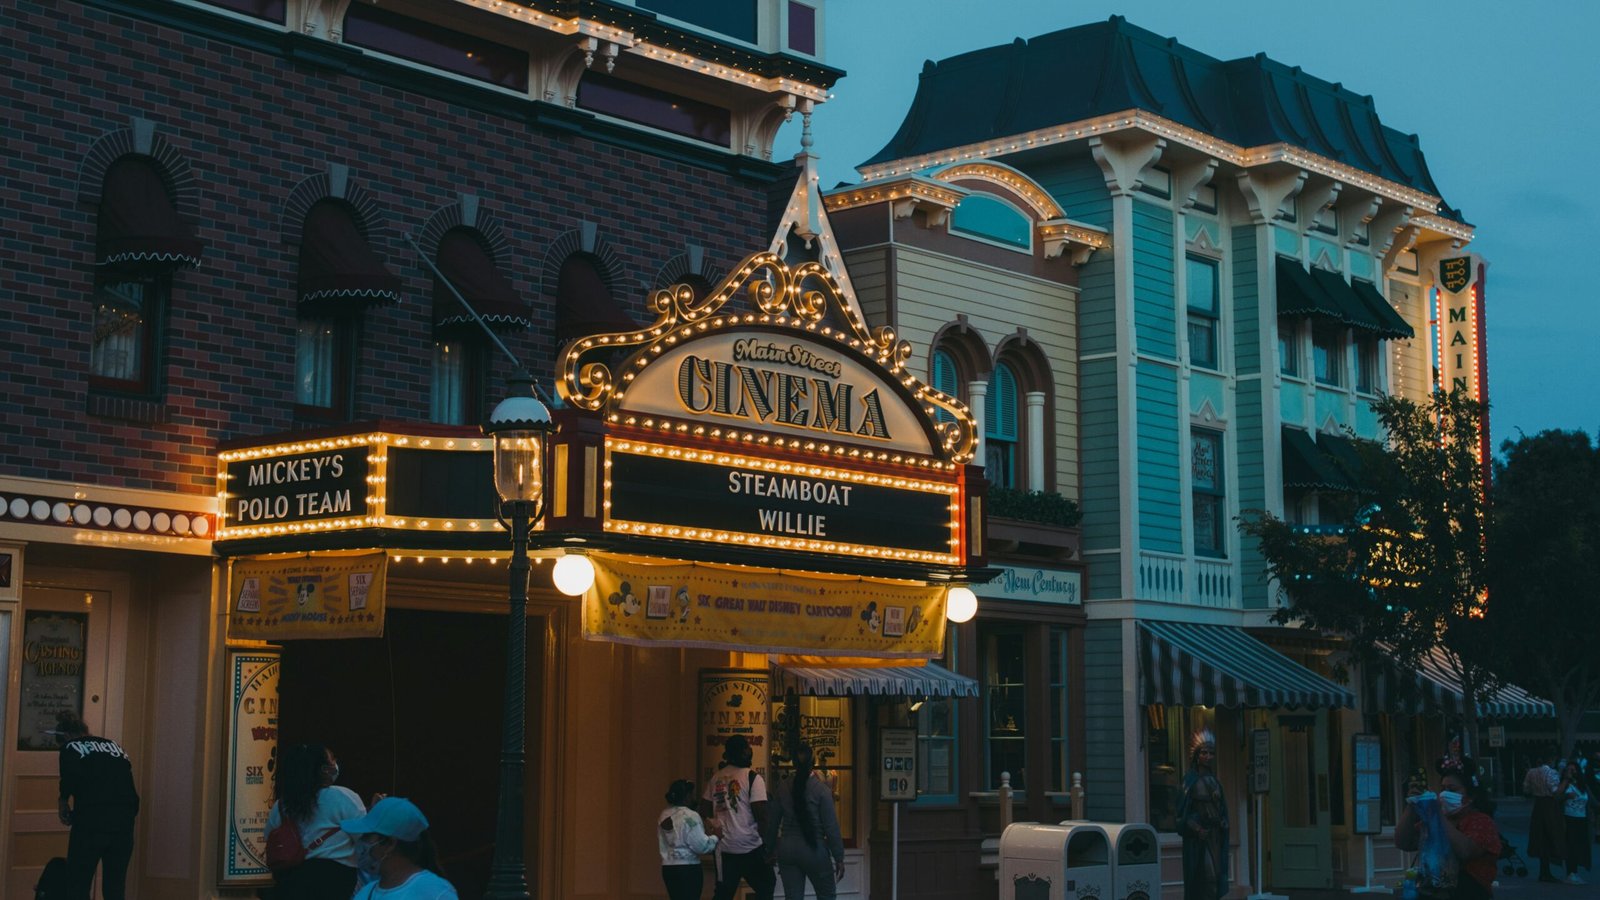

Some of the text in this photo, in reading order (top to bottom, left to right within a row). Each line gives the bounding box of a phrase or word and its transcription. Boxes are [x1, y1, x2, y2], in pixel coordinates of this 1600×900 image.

[734, 338, 842, 378] Main Street
[1449, 306, 1467, 393] MAIN
[675, 354, 892, 441] CINEMA
[248, 455, 344, 487] MICKEY'S
[728, 471, 852, 507] STEAMBOAT
[238, 489, 352, 522] POLO TEAM
[758, 508, 827, 537] WILLIE
[1032, 570, 1077, 602] Century
[715, 596, 745, 611] GREAT
[768, 600, 801, 615] DISNEY
[243, 697, 279, 714] CIN
[246, 766, 264, 777] SIX
